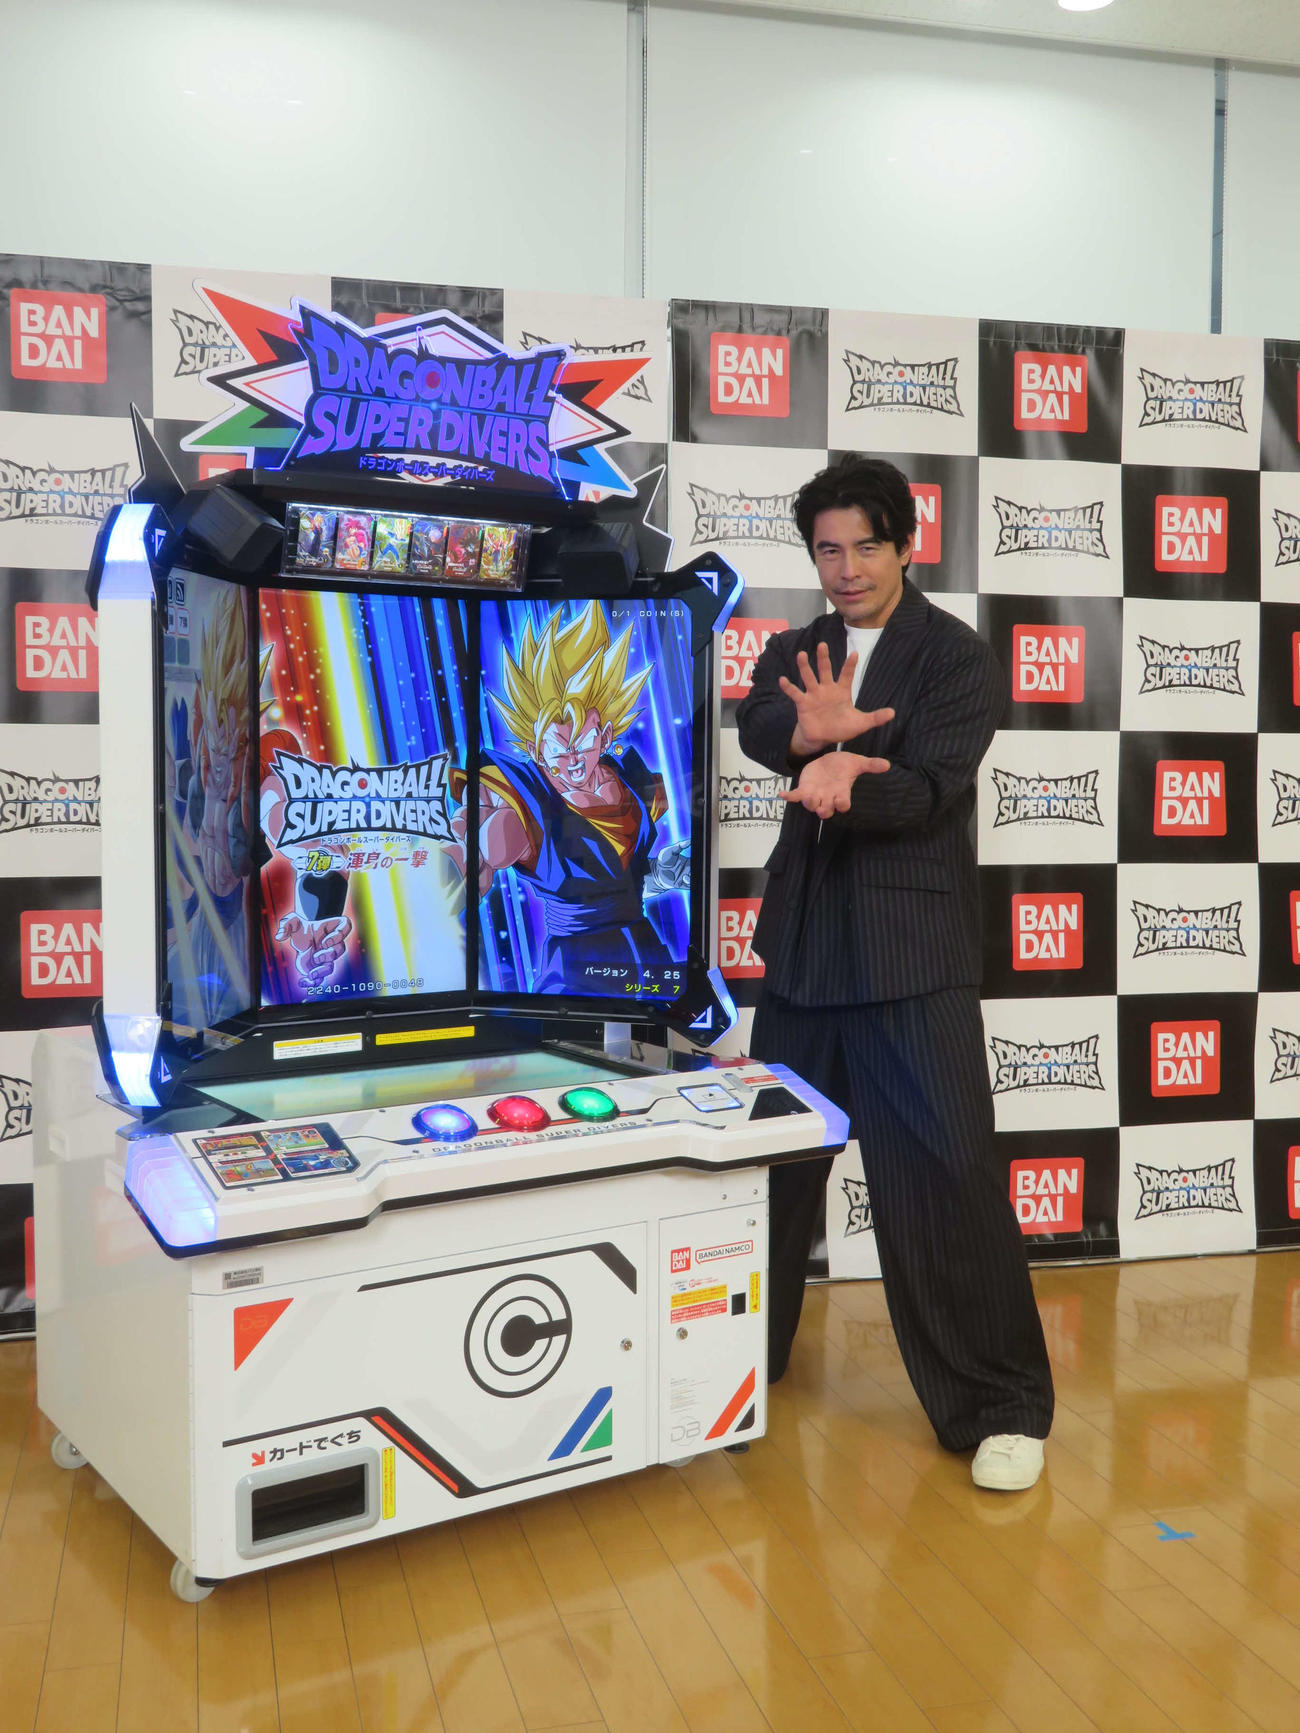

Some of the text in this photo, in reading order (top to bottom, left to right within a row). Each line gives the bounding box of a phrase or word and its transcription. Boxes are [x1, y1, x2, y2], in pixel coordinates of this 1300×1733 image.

[19, 302, 99, 338] BAN
[20, 335, 83, 370] DAI
[718, 344, 783, 376] BAN
[718, 376, 769, 405] DAI
[1021, 363, 1082, 393] BAN
[848, 382, 961, 413] SUPER DIVERS
[1020, 392, 1070, 420] DAI
[1140, 400, 1245, 430] SUPER DIVERS
[297, 395, 555, 483] SUPER DIVERS
[359, 455, 495, 482] ドラゴンボールスーパーダイバーズ
[692, 517, 750, 543] SUPER
[1161, 507, 1222, 534] BAN
[996, 528, 1107, 557] SUPER DIVERS
[1161, 535, 1209, 561] DAI
[25, 615, 99, 647] BAN
[1019, 636, 1079, 663] BAN
[25, 649, 87, 679] DAI
[721, 659, 756, 686] DA
[1019, 665, 1065, 691] DAI
[1141, 666, 1243, 694] SUPER DIVERS
[1162, 772, 1220, 797] BAN
[0, 803, 66, 832] SUPER
[282, 800, 453, 840] SUPER DIVERS
[996, 799, 1102, 825] SUPER DIVERS
[1161, 800, 1209, 825] DAI
[720, 910, 758, 938] BA
[1019, 904, 1078, 931] BAN
[30, 923, 103, 953] BAN
[1019, 932, 1065, 959] DAI
[1136, 929, 1244, 956] SUPER DIVERS
[720, 940, 763, 967] DA
[30, 955, 92, 985] DAI
[585, 966, 628, 977] バージョン
[307, 978, 425, 995] 2240-1090-0048
[625, 984, 680, 994] シリーズ 7
[1157, 1031, 1215, 1059] BAN
[995, 1064, 1103, 1093] SUPER DIVERS
[1157, 1059, 1202, 1086] DAI
[536, 1126, 582, 1139] SUPER
[587, 1120, 639, 1131] DIVERS
[1016, 1169, 1078, 1195] BAN
[1016, 1196, 1064, 1223] DAI
[1138, 1187, 1241, 1217] SUPER DIVERS
[672, 1251, 689, 1261] BAN
[672, 1260, 686, 1270] DAI
[698, 1244, 751, 1259] BANDAI NAMCO
[269, 1429, 362, 1462] カードでぐち
